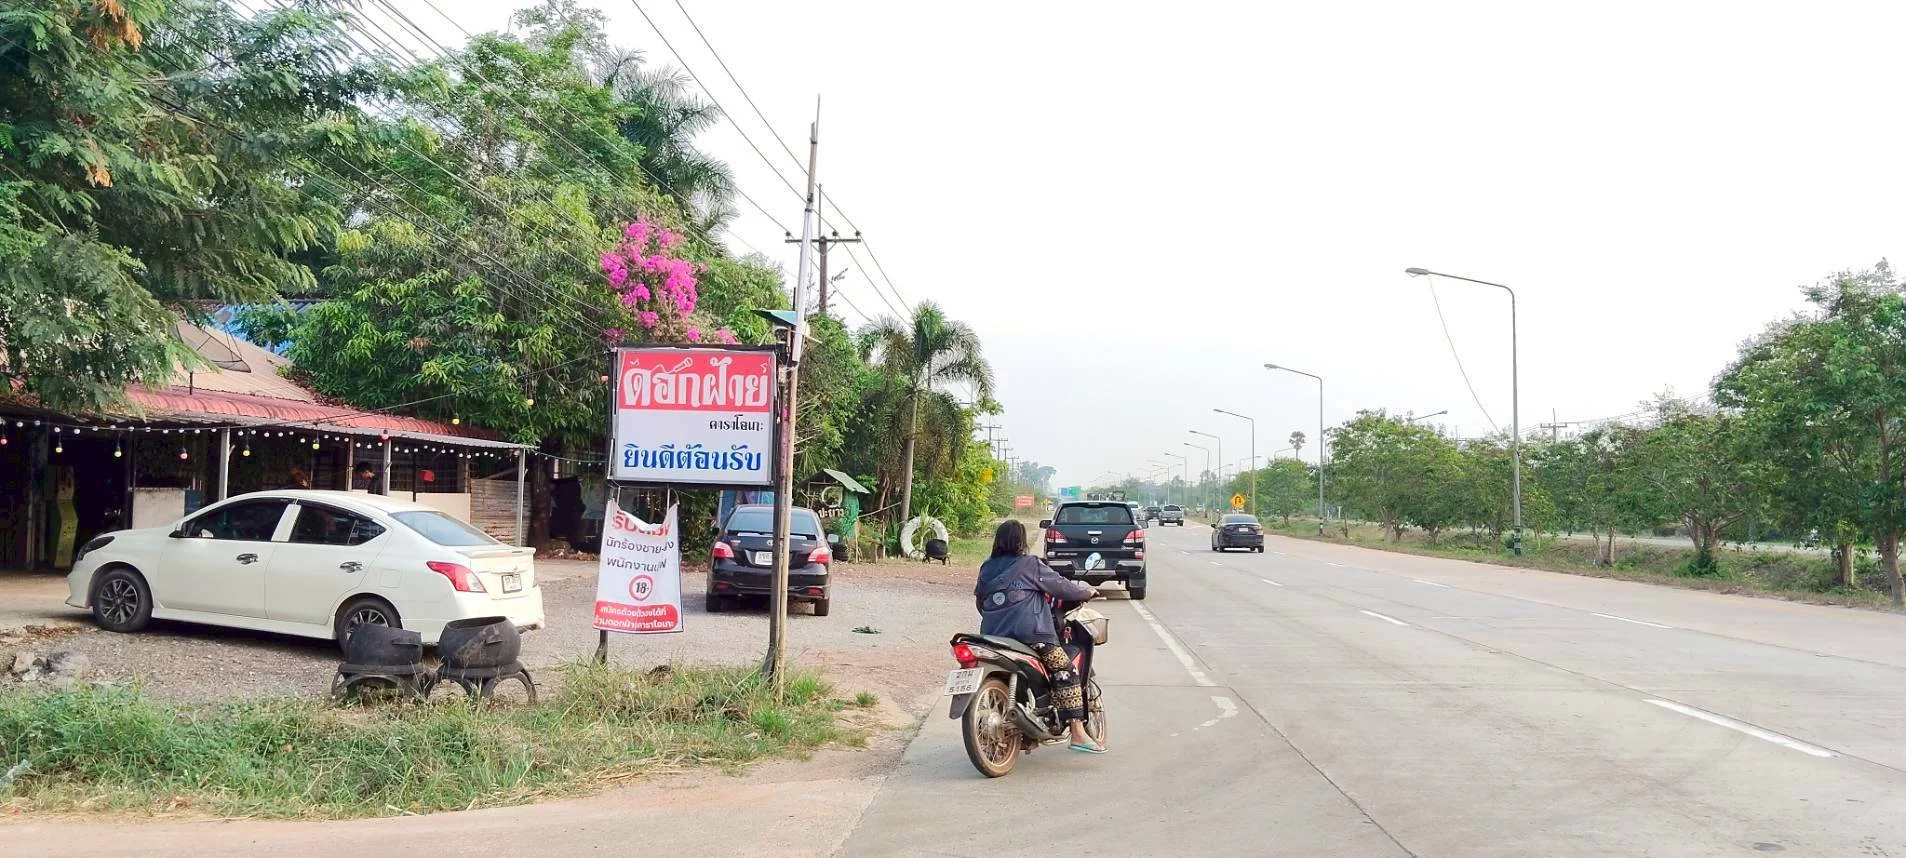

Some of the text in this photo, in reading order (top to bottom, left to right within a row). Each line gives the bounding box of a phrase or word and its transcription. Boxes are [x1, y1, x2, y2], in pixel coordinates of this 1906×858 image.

[709, 414, 764, 431] คาราโอเกะ
[624, 443, 762, 470] ยินดีต้อนรับ
